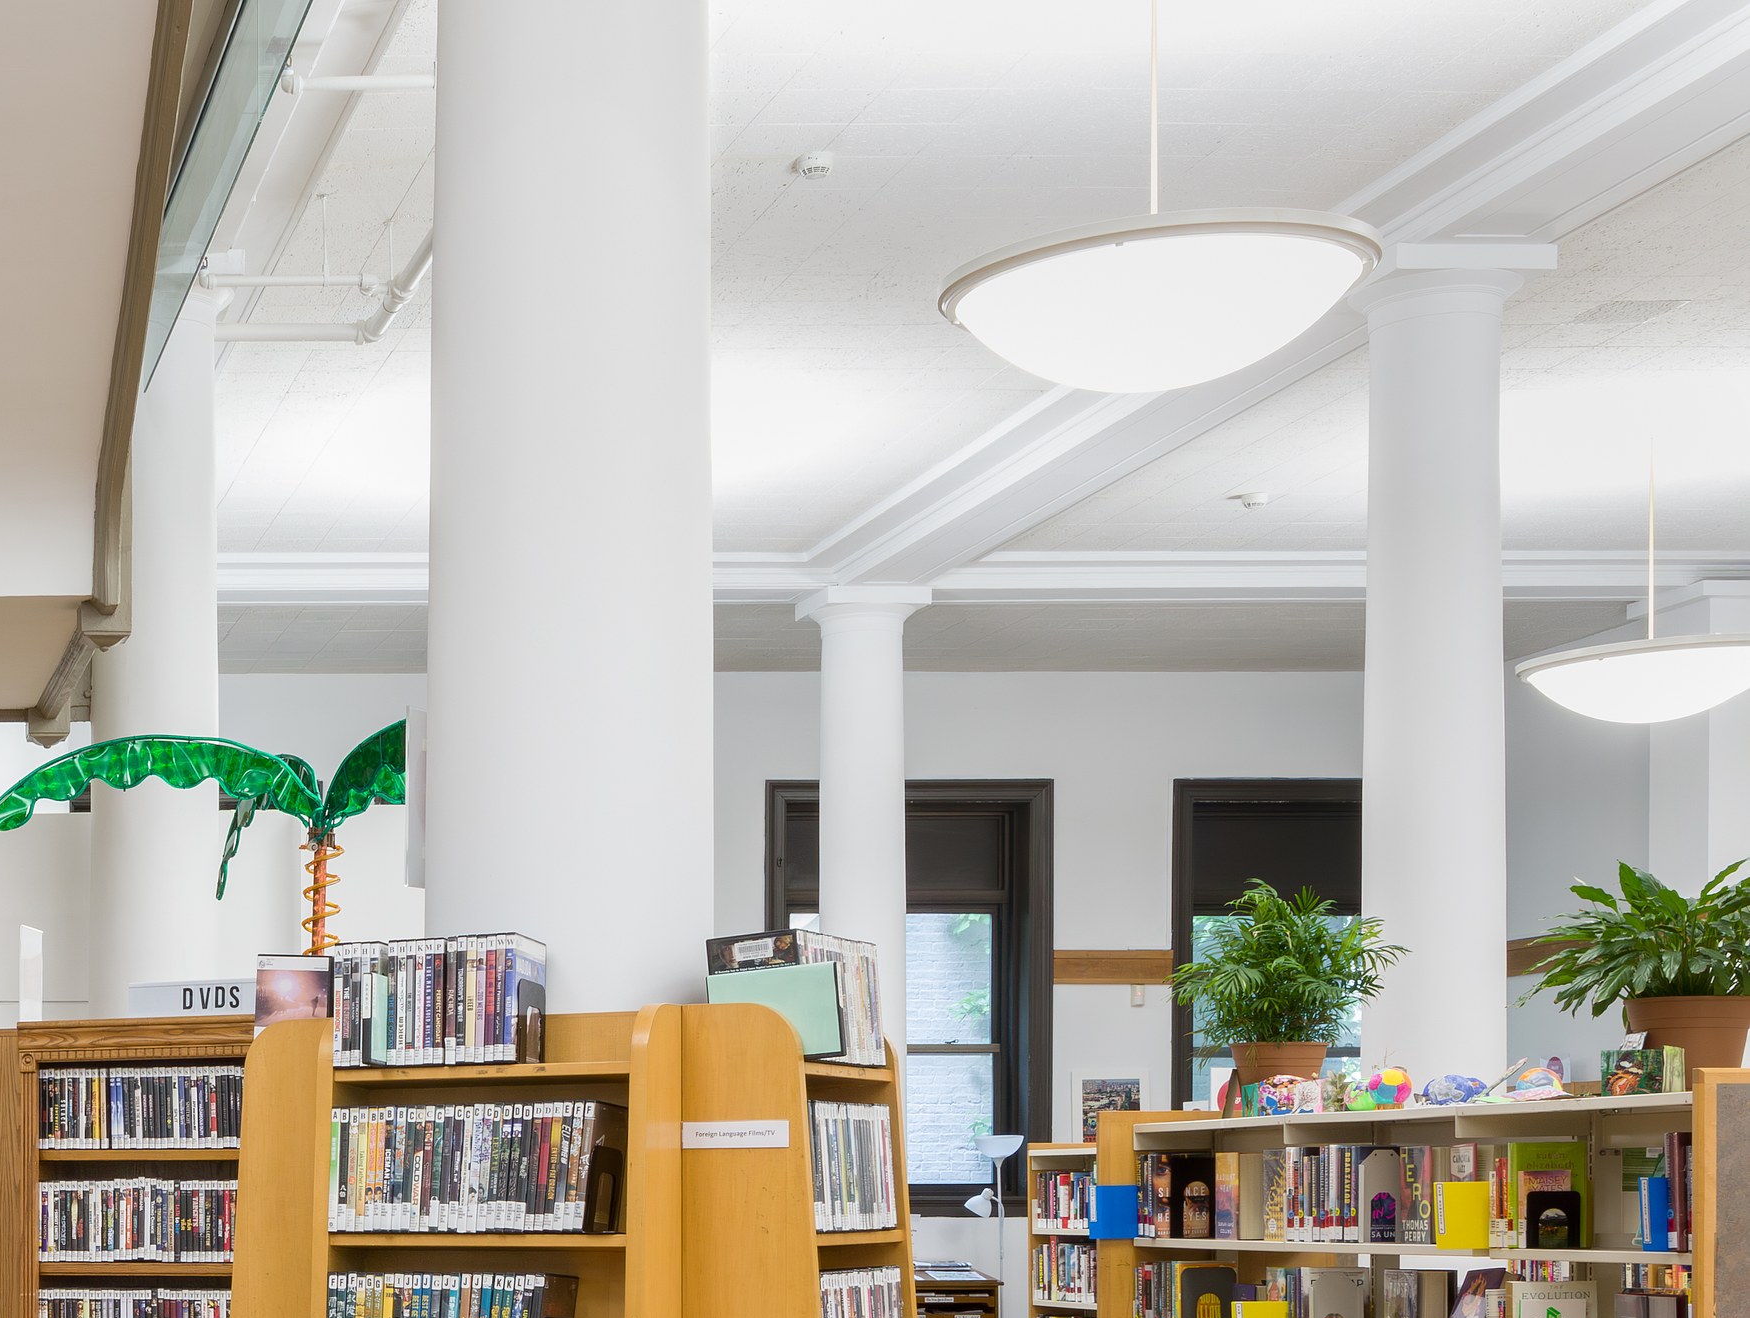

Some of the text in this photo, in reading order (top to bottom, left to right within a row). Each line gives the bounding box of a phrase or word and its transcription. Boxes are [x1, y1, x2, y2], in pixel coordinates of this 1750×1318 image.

[446, 989, 455, 1016] RACHIDA
[1536, 1151, 1566, 1160] susan
[1525, 1160, 1575, 1171] elizabeth
[1528, 1175, 1568, 1186] MAISEY
[1530, 1184, 1563, 1192] YATES
[1401, 1219, 1429, 1231] THOMAS
[1404, 1231, 1427, 1242] PERRY
[1521, 1291, 1591, 1300] EVOLUTION
